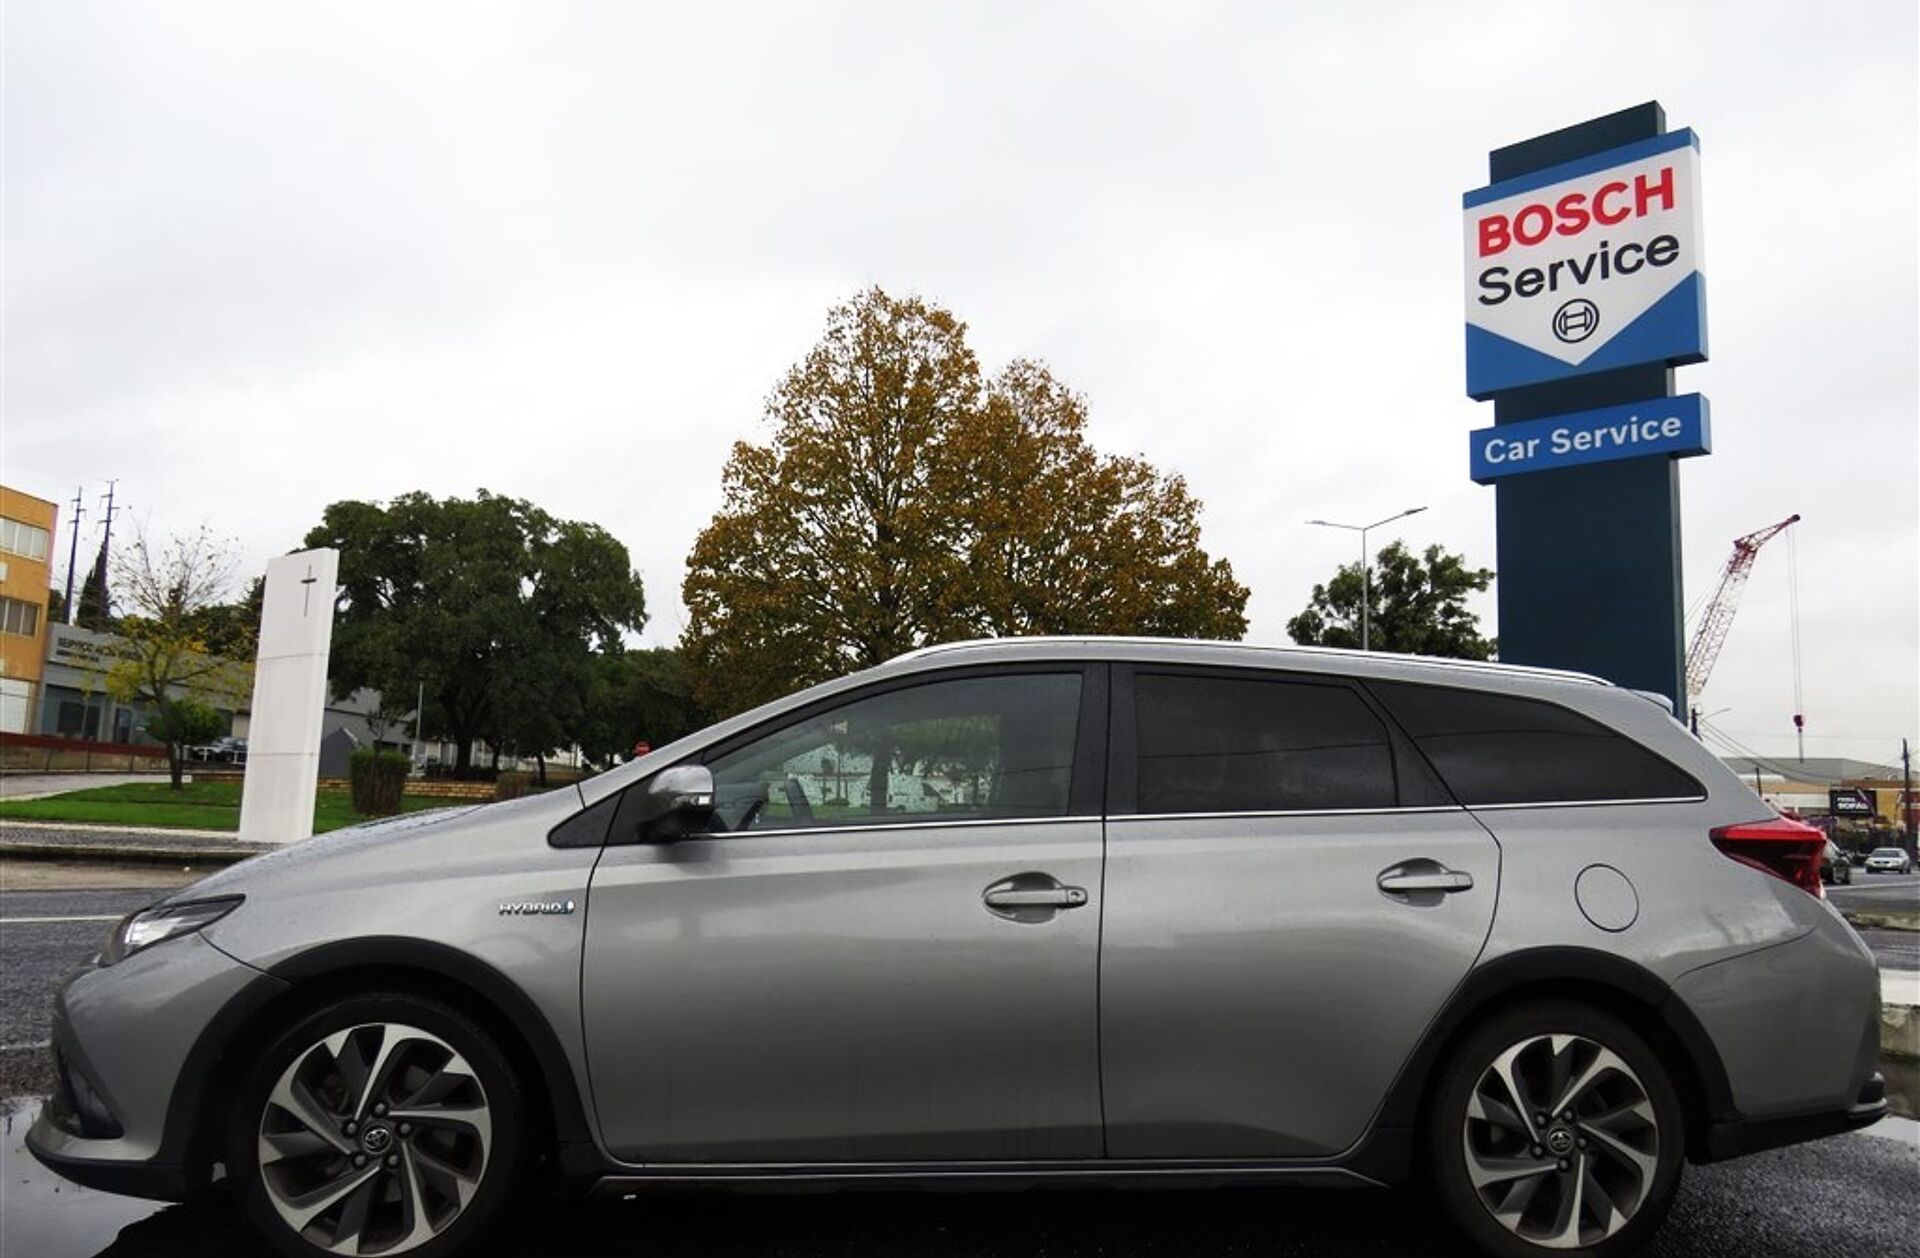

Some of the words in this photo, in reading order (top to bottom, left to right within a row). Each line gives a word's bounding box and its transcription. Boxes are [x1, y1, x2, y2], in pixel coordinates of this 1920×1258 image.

[1478, 167, 1675, 258] BOSCH
[1478, 234, 1680, 306] Service
[1484, 437, 1540, 464] Car
[1551, 415, 1682, 455] Service
